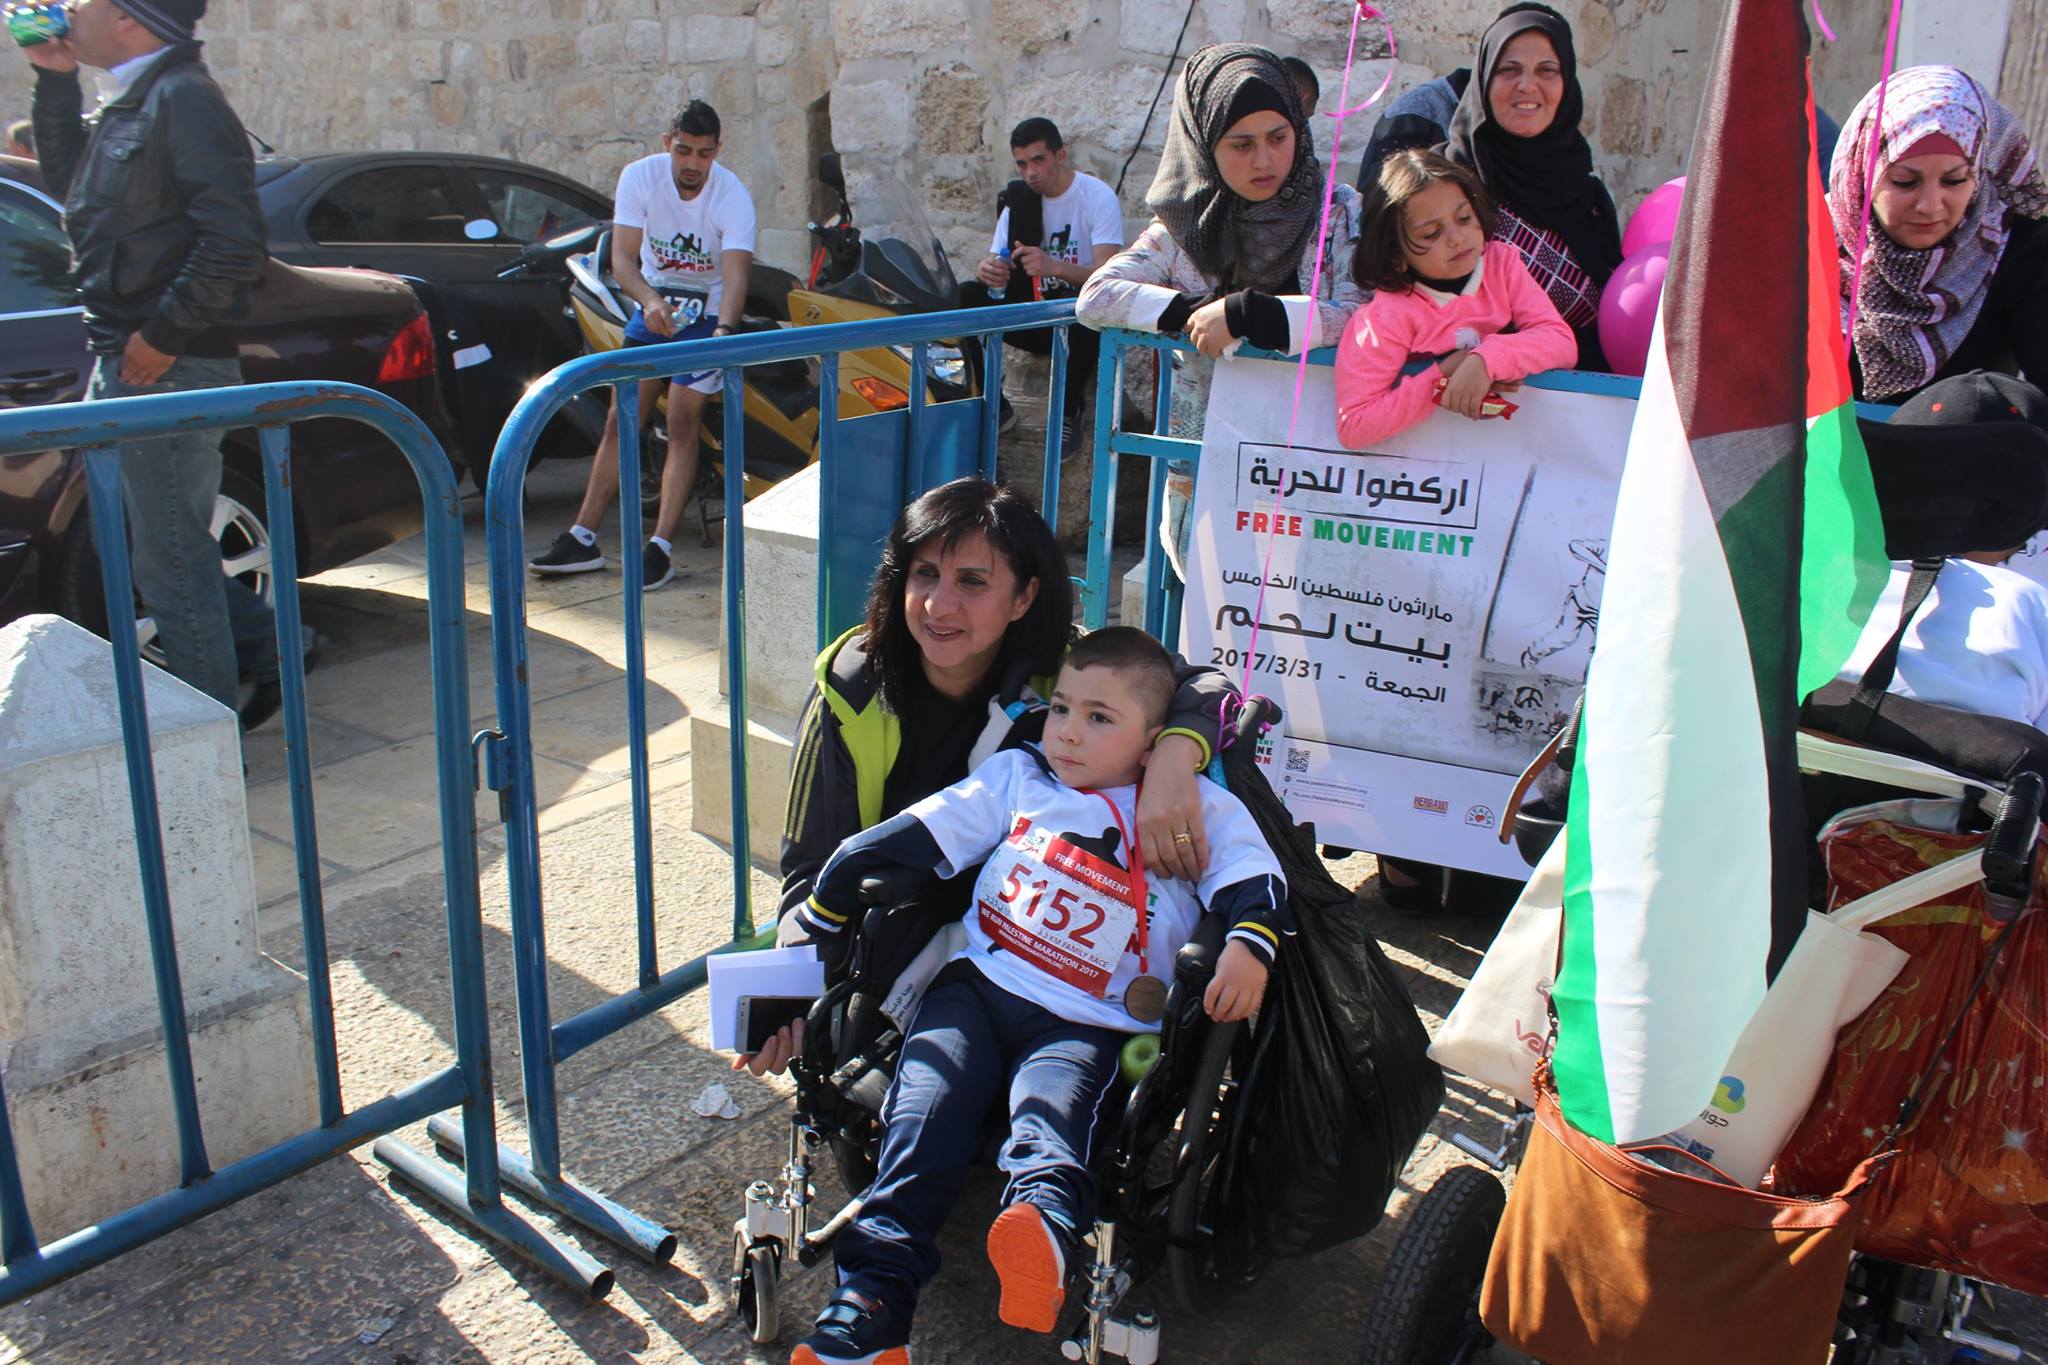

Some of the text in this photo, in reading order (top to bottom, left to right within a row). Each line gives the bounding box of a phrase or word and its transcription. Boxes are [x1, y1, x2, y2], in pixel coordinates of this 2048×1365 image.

[1250, 457, 1469, 515] اركضوا للحرية
[1236, 511, 1474, 557] FREE MOVEMENT
[1222, 568, 1453, 623] ماراثون فلسطين الخمس
[1216, 604, 1451, 668] بيت لحم
[1210, 647, 1323, 681] 2017/3/31
[1365, 671, 1446, 703] الجمعة
[1055, 852, 1131, 894] FREE MOVEMENT
[997, 863, 1105, 949] 5152
[1002, 921, 1033, 945] PALESTINE
[1035, 940, 1078, 968] MARATHON
[1079, 964, 1099, 978] 2017
